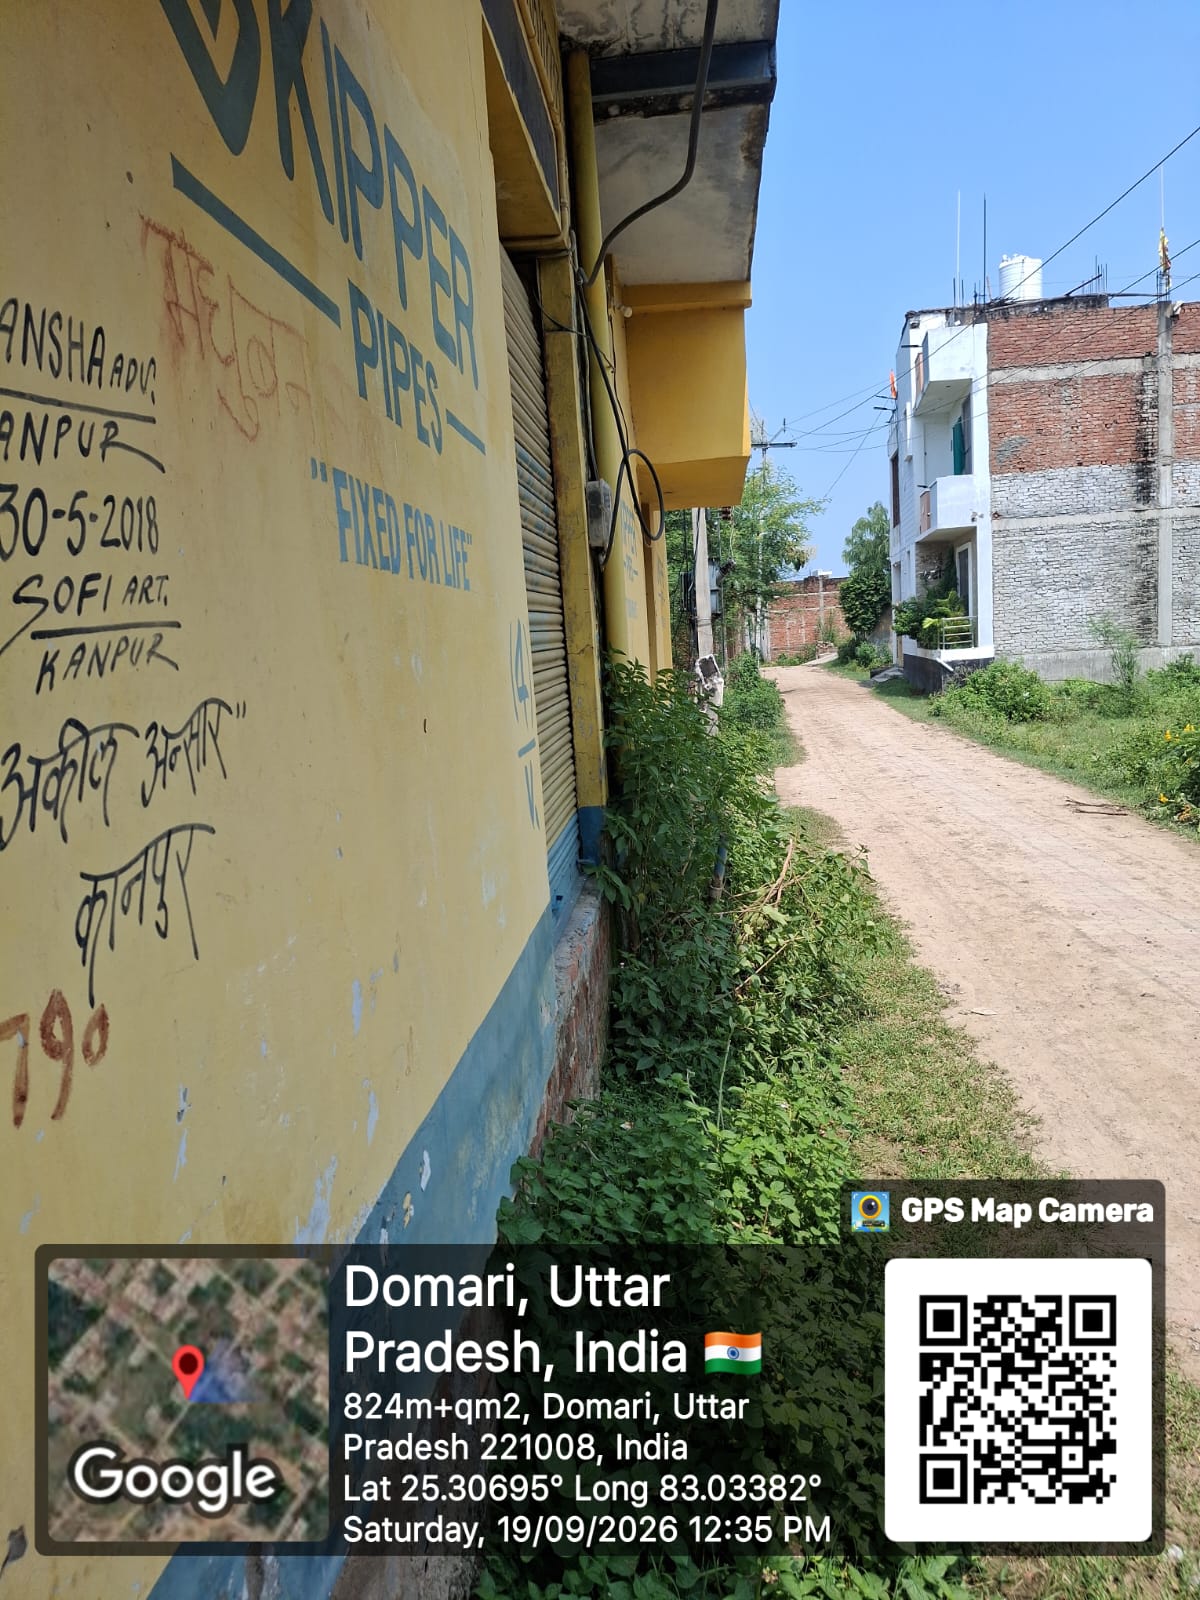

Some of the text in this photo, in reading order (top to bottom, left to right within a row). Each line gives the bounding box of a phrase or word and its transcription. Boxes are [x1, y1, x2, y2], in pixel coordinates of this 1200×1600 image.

[347, 278, 443, 456] PIPES
[403, 502, 441, 585] FOR
[0, 574, 112, 655] SOFI
[36, 633, 179, 695] KANPUR
